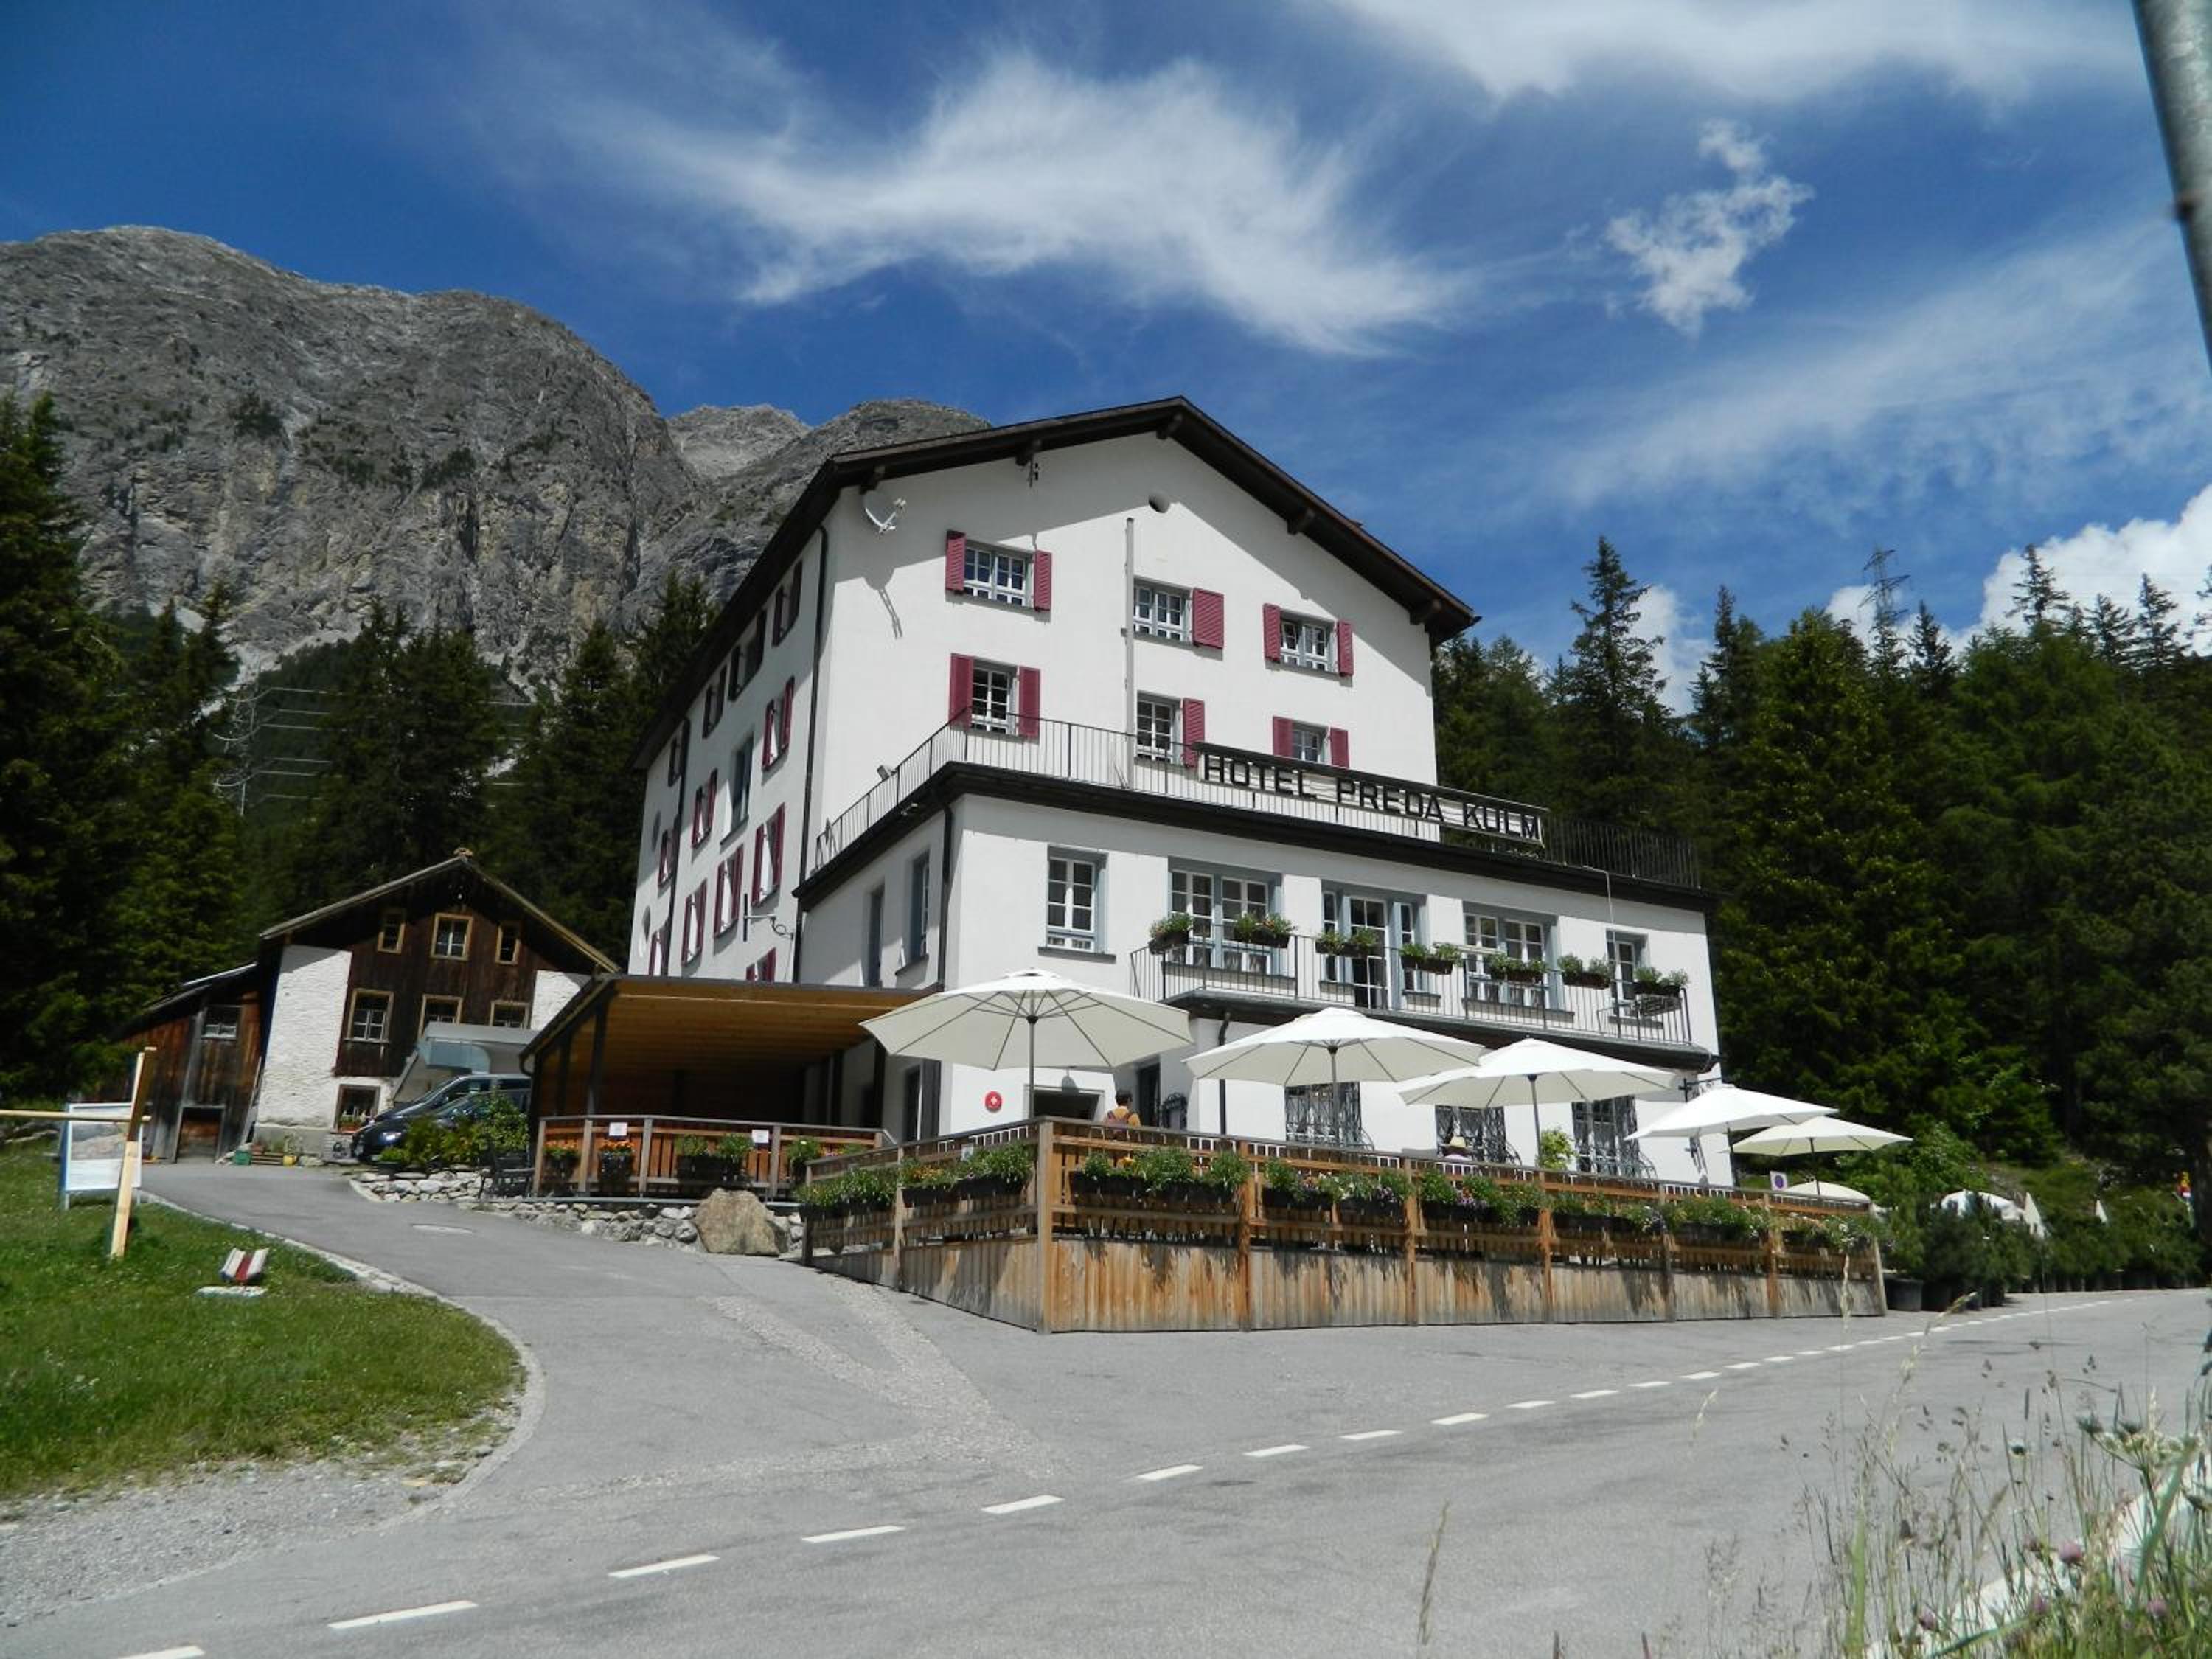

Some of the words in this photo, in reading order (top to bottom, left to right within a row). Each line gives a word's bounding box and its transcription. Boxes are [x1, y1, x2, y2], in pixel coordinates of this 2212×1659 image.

[1205, 753, 1317, 799] HOTEL
[1336, 777, 1444, 822] PREDA
[1462, 801, 1539, 840] KULM
